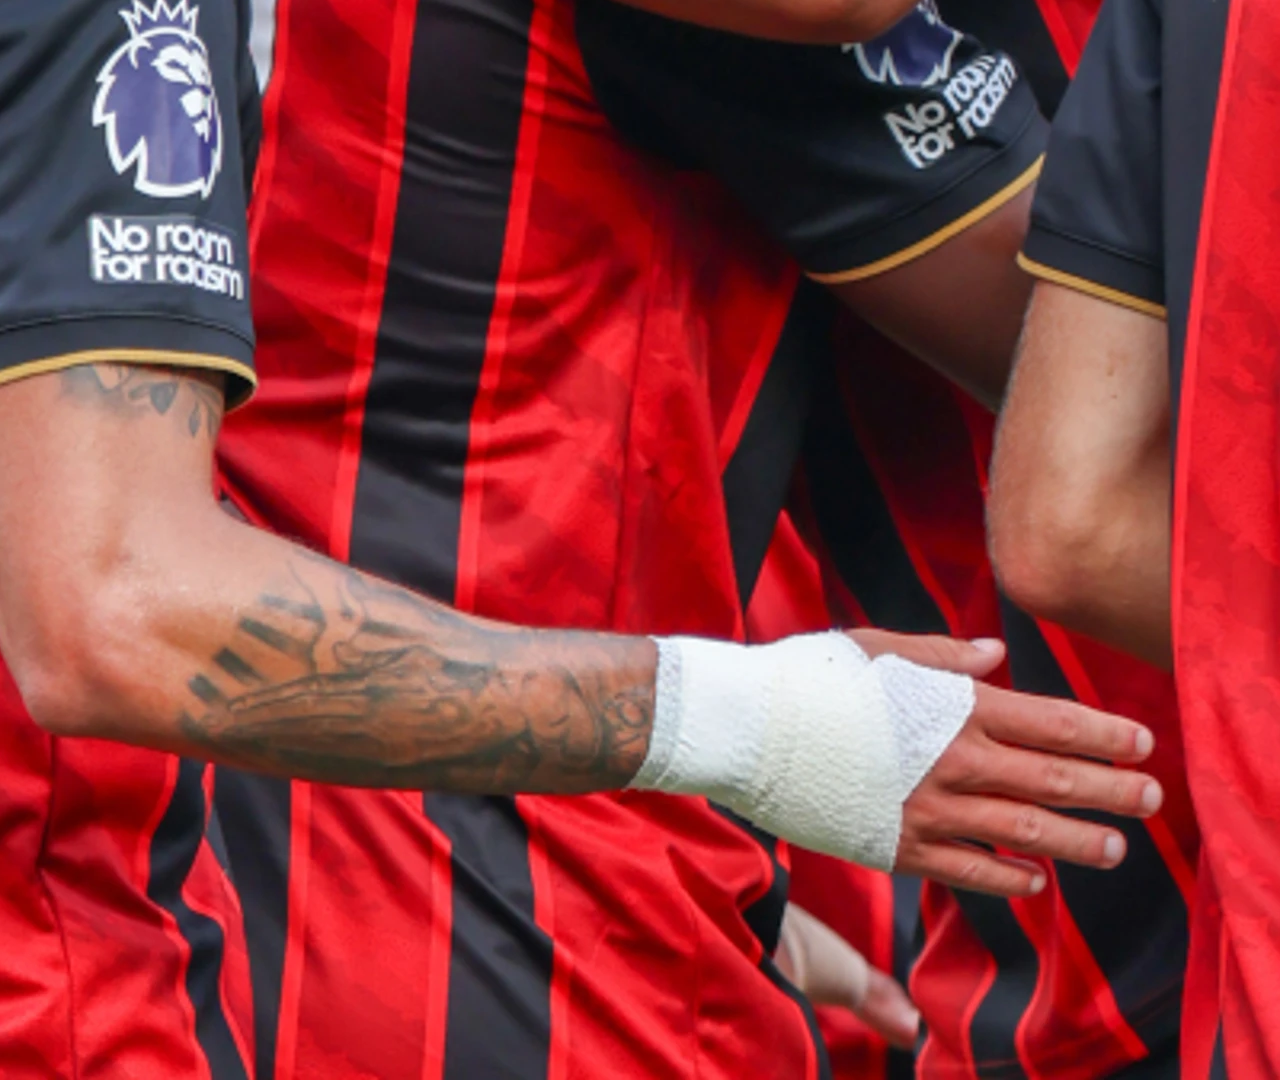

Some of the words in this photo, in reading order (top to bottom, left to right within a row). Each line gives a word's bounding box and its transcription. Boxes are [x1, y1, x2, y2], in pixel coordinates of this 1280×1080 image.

[884, 101, 946, 142] No
[903, 122, 955, 169] for
[91, 218, 150, 253] No
[156, 224, 234, 265] room
[93, 248, 150, 282] for
